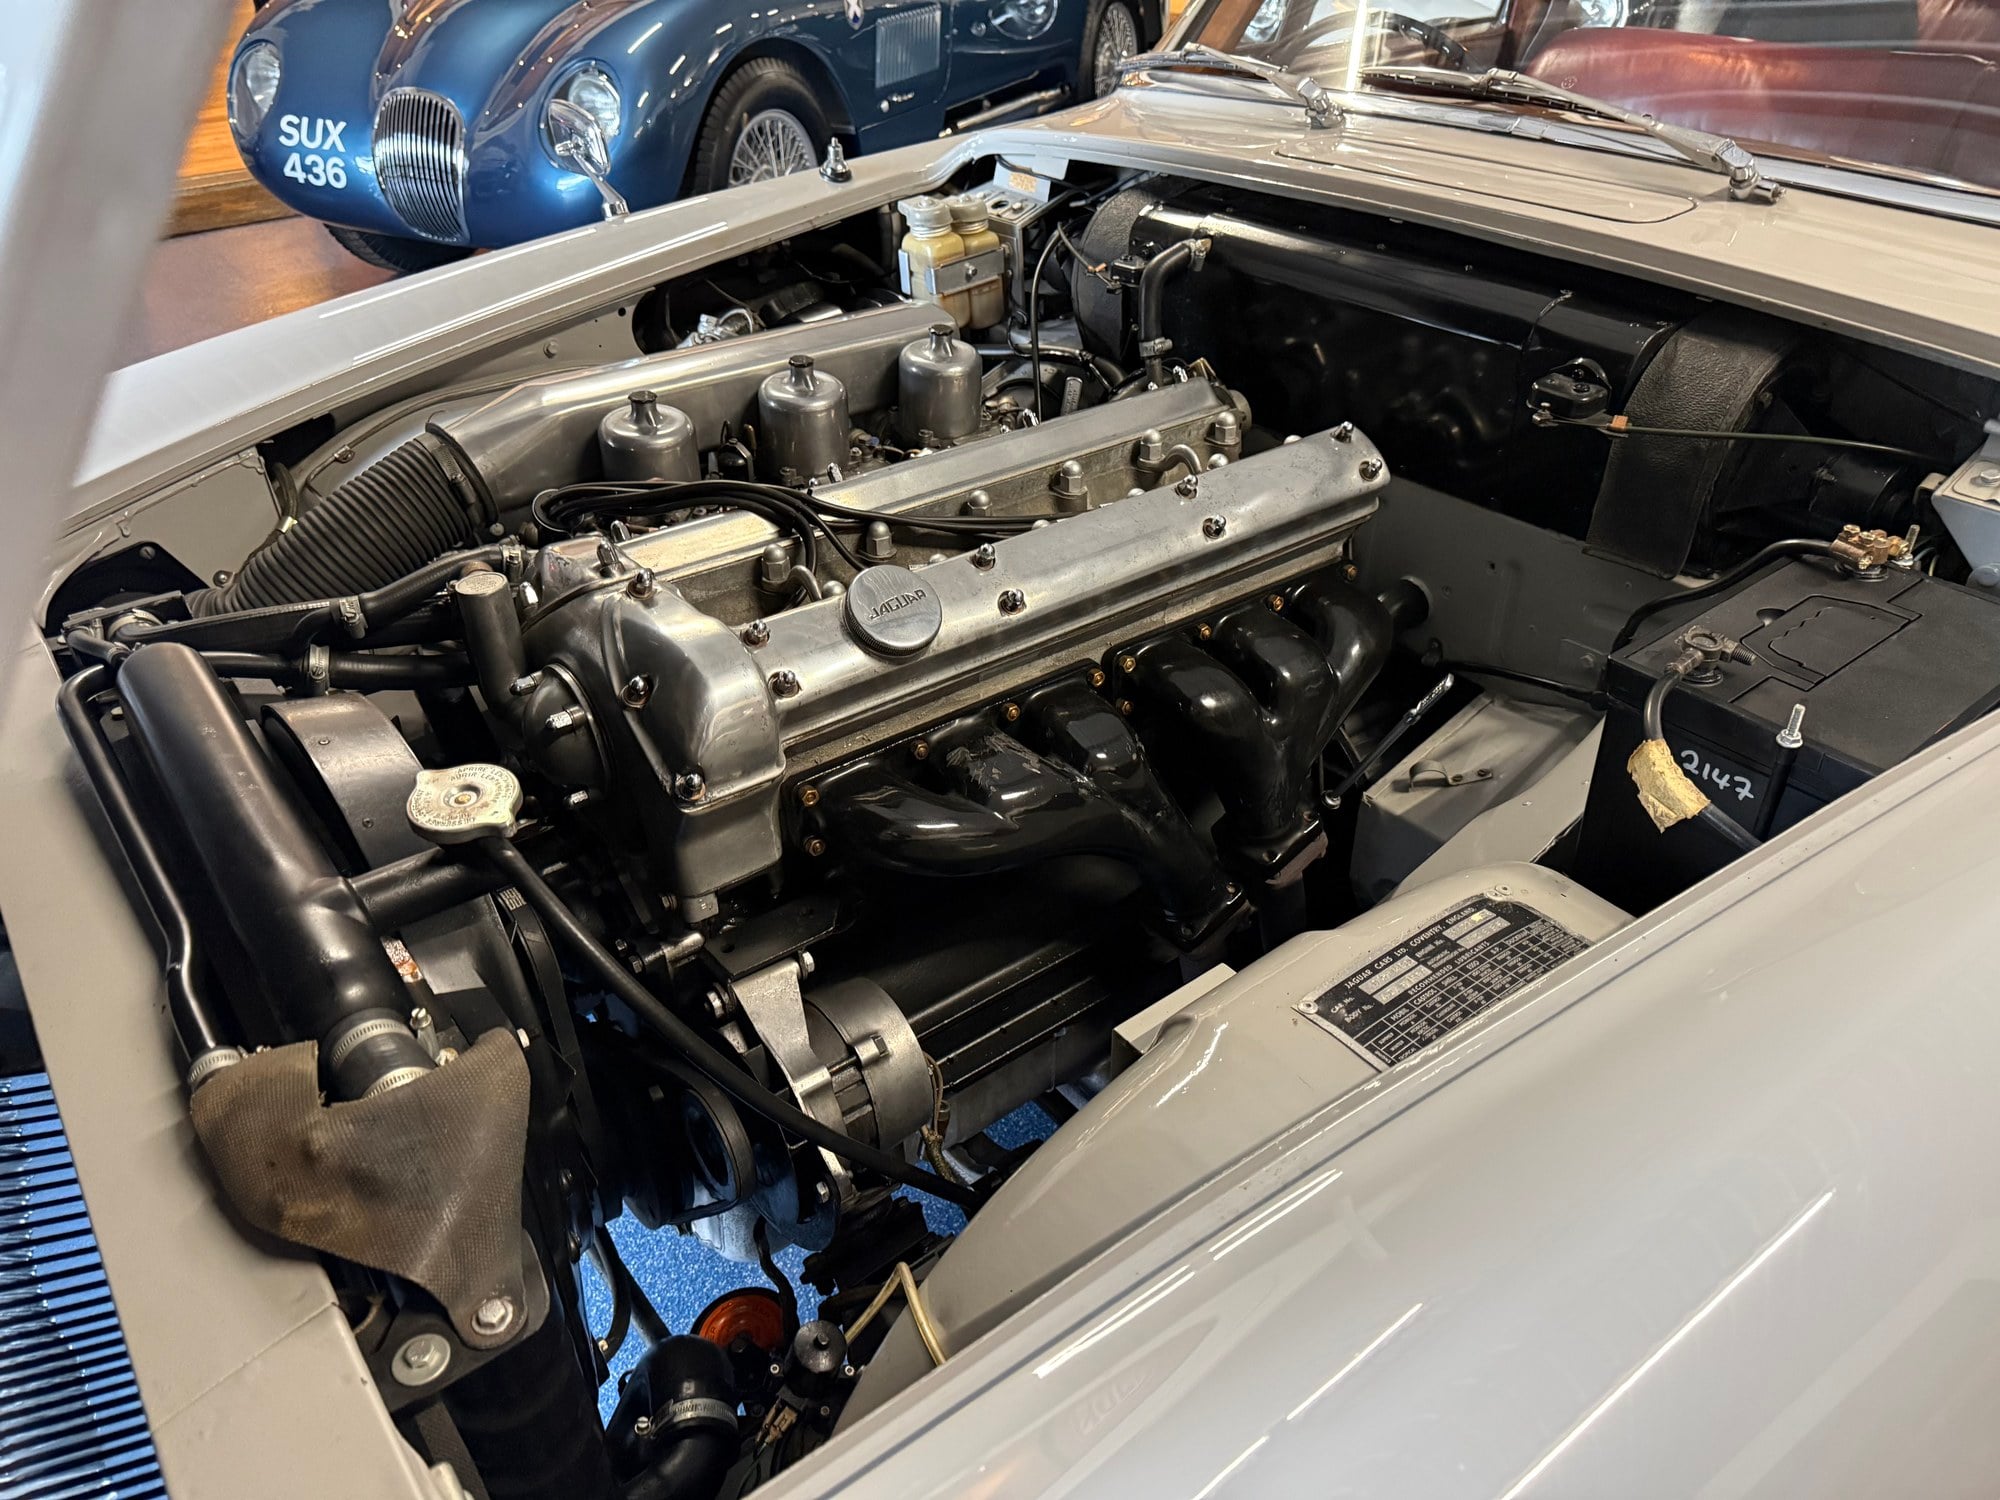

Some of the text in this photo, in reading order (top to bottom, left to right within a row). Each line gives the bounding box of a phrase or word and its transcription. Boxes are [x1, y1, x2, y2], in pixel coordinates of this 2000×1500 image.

[278, 114, 347, 152] SUX
[283, 152, 347, 189] 436
[870, 589, 927, 620] JAGUAR
[1680, 750, 1754, 801] 2147
[1344, 968, 1373, 989] JAGUAR
[1374, 955, 1393, 969] CARS
[1408, 964, 1453, 995] RECOMMENDED
[1454, 941, 1490, 965] LUBRICANTS
[1390, 1007, 1410, 1021] MOBIL
[1413, 988, 1438, 1005] CASTROL
[1441, 974, 1459, 988] SHELL
[1466, 960, 1480, 970] ESSO
[1344, 1009, 1362, 1023] BODY
